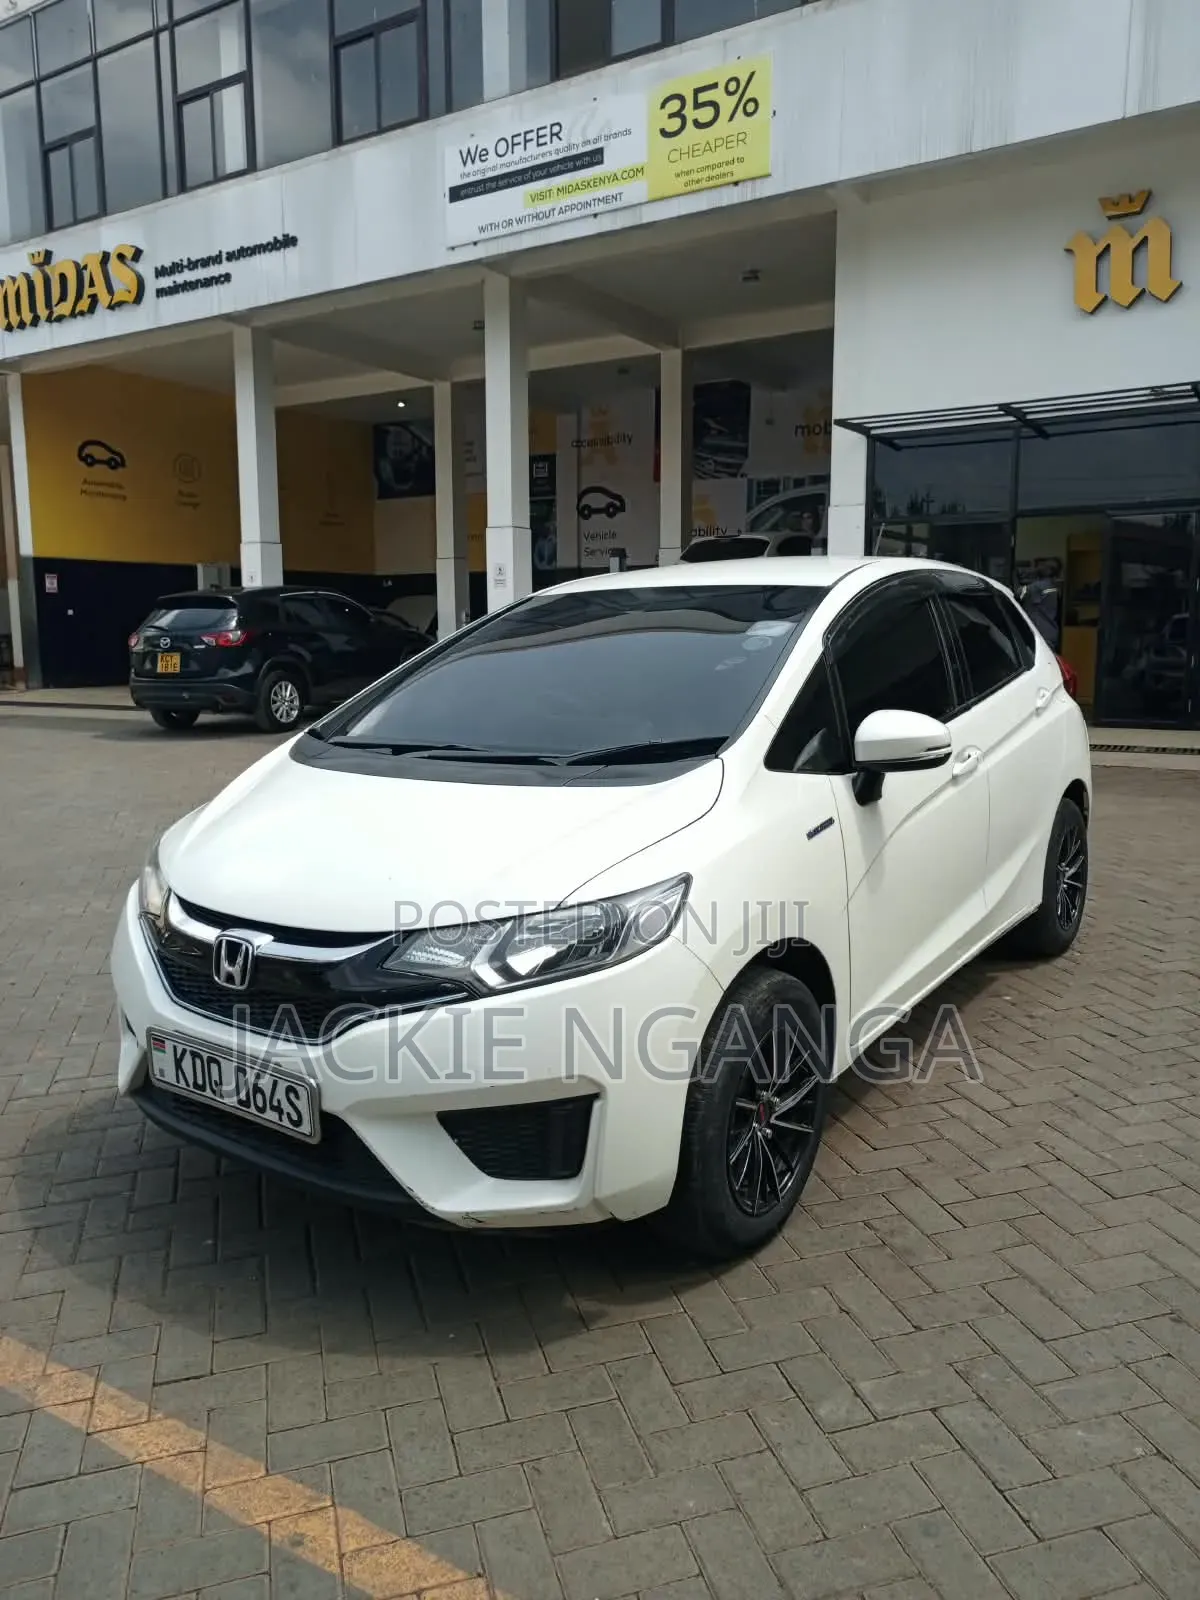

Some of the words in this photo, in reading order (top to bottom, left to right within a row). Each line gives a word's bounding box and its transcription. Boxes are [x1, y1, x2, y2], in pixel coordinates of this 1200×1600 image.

[658, 70, 760, 139] 35%
[459, 144, 489, 167] We
[495, 121, 563, 158] OFFER
[460, 170, 472, 180] the
[472, 163, 498, 177] original
[500, 150, 553, 168] manufacturers
[554, 143, 579, 156] quality
[604, 128, 632, 141] brands
[667, 131, 748, 164] CHEAPER
[576, 155, 591, 167] with
[674, 167, 695, 179] when
[696, 156, 735, 174] compared
[736, 155, 745, 164] to
[556, 166, 645, 197] MIDASKENYA.COM
[683, 176, 704, 188] other
[705, 170, 734, 182] dealers
[478, 221, 500, 234] WITH
[501, 218, 514, 230] OR
[514, 207, 556, 225] WITHOUT
[557, 191, 624, 216] APPOINTMENT
[154, 249, 223, 280] Multi-brand
[225, 233, 298, 263] automobile
[156, 272, 232, 299] maintenance
[583, 530, 617, 541] Vehicle
[584, 546, 613, 557] Servic
[172, 1044, 224, 1099] KDQ
